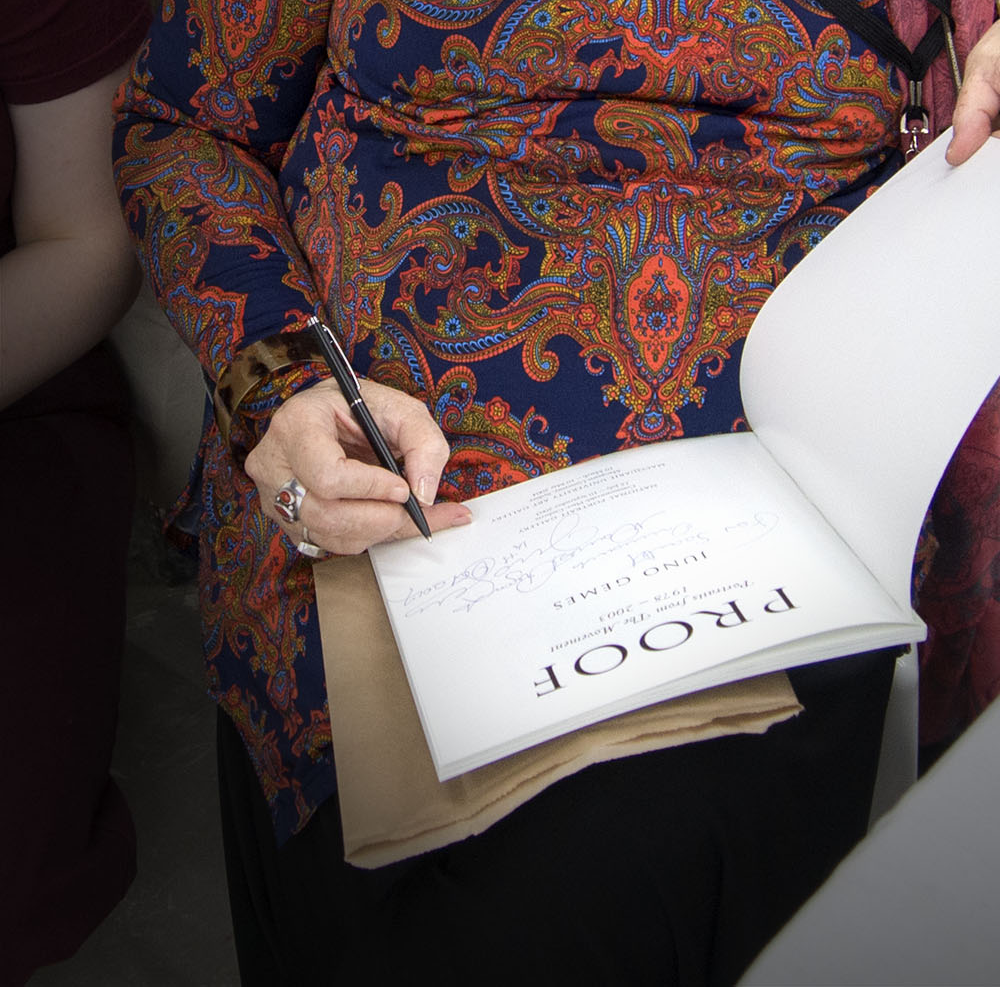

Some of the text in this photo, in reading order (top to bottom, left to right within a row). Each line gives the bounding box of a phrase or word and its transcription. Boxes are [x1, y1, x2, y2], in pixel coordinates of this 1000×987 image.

[643, 551, 708, 577] JUNO
[553, 576, 632, 611] GEMES
[653, 586, 688, 602] 1978
[550, 580, 755, 653] Portraits from The Movement
[598, 605, 635, 623] 2003
[533, 586, 800, 698] PROOF
